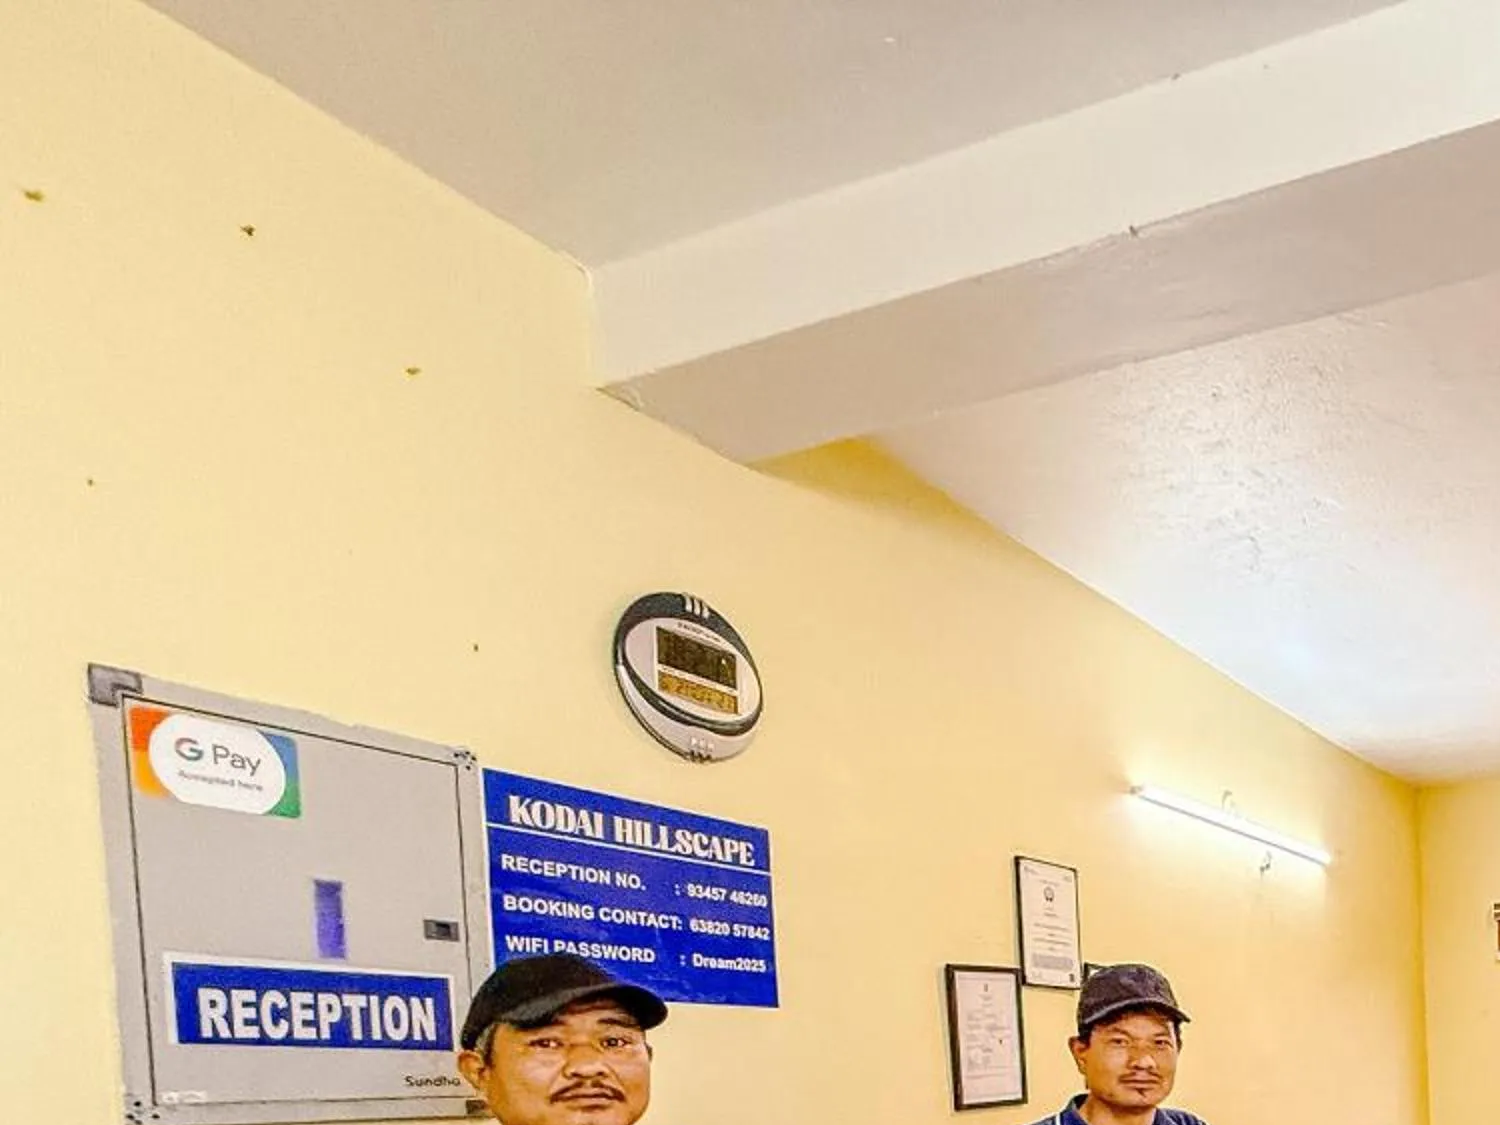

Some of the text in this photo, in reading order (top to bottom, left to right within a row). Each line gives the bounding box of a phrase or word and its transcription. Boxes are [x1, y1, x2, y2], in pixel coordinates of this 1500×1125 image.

[175, 737, 262, 777] G Pay
[508, 794, 756, 867] KODAI HILLSCAPE
[501, 853, 611, 885] RECEPTION
[615, 871, 647, 892] NO.
[502, 894, 595, 920] BOOKING
[598, 906, 683, 931] CONTACT:
[504, 934, 550, 954] WIFI
[553, 939, 656, 963] PASSWORD
[692, 952, 768, 974] Dream2025
[197, 986, 437, 1042] RECEPTION
